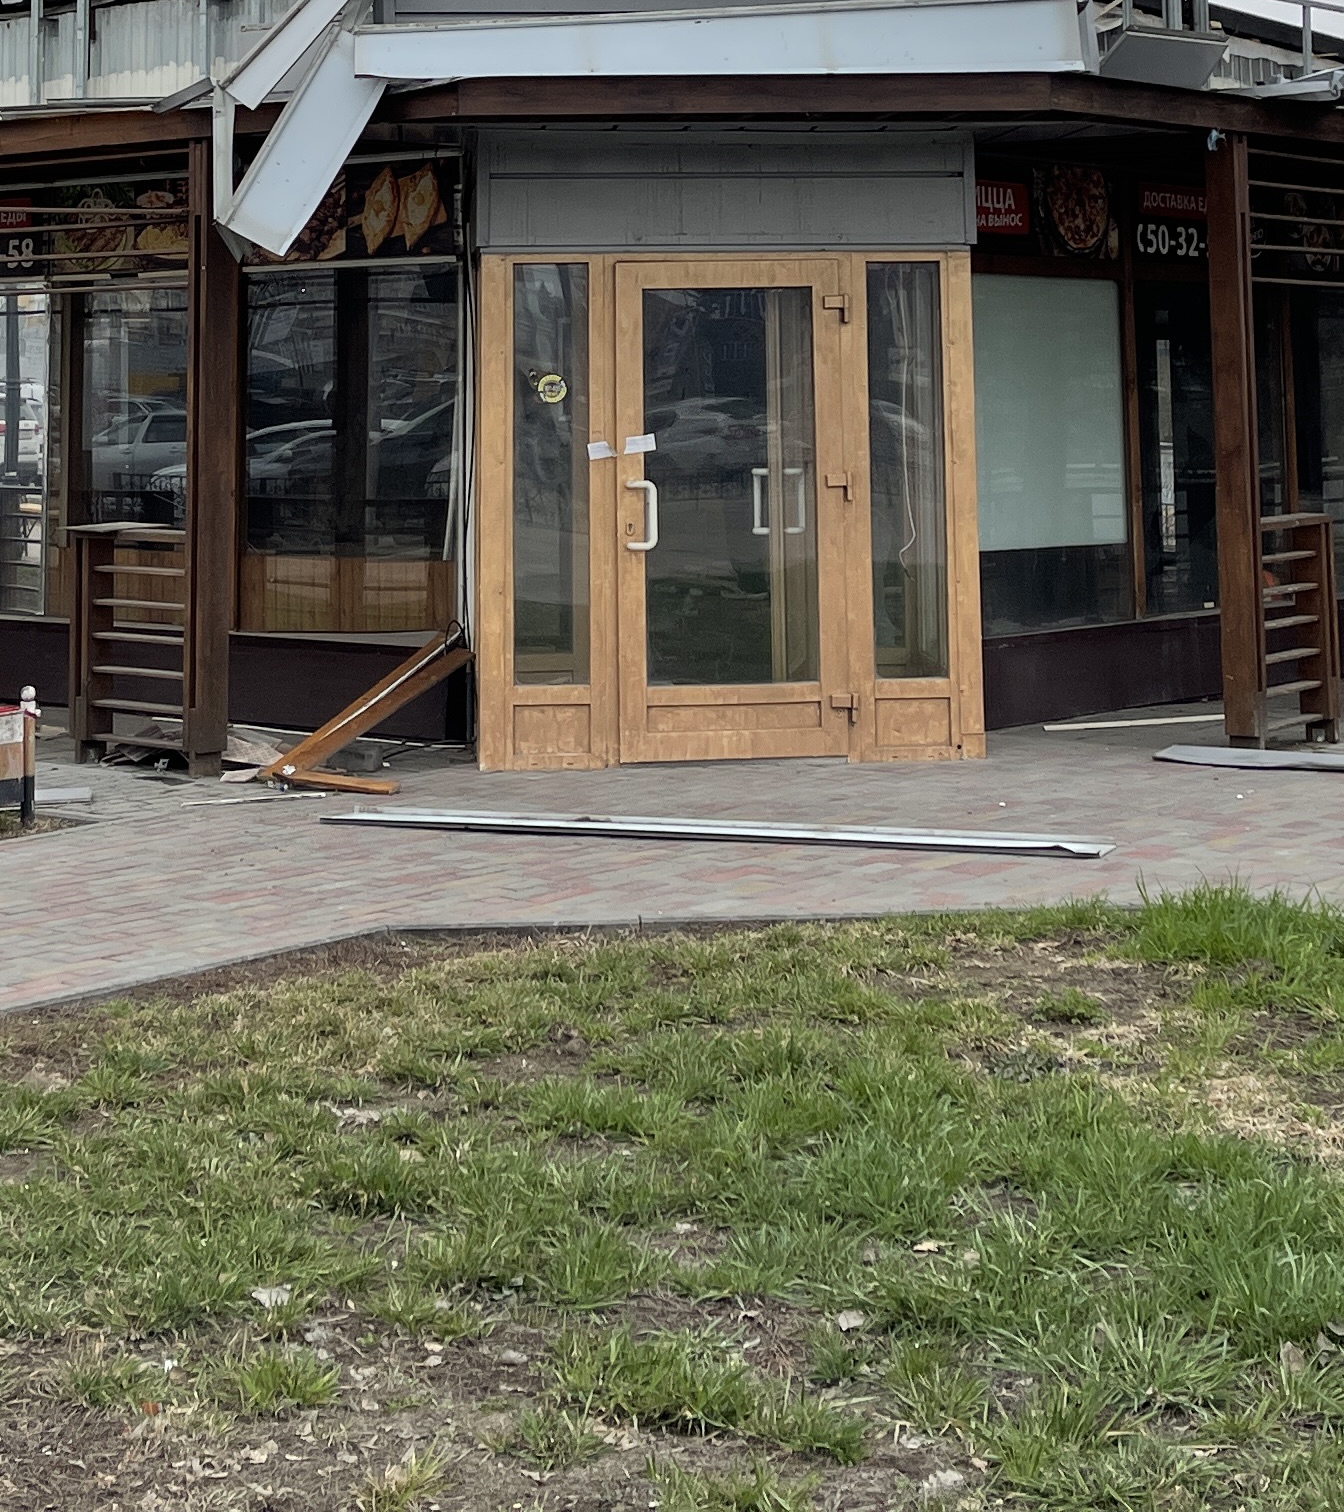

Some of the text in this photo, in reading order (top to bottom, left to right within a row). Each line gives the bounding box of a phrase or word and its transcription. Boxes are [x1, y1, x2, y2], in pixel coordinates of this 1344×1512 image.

[1143, 191, 1197, 209] ДОСТАВКА
[0, 211, 27, 227] ЕДЫ
[988, 213, 1023, 227] ВЫНОС
[1146, 224, 1209, 257] 50-32-
